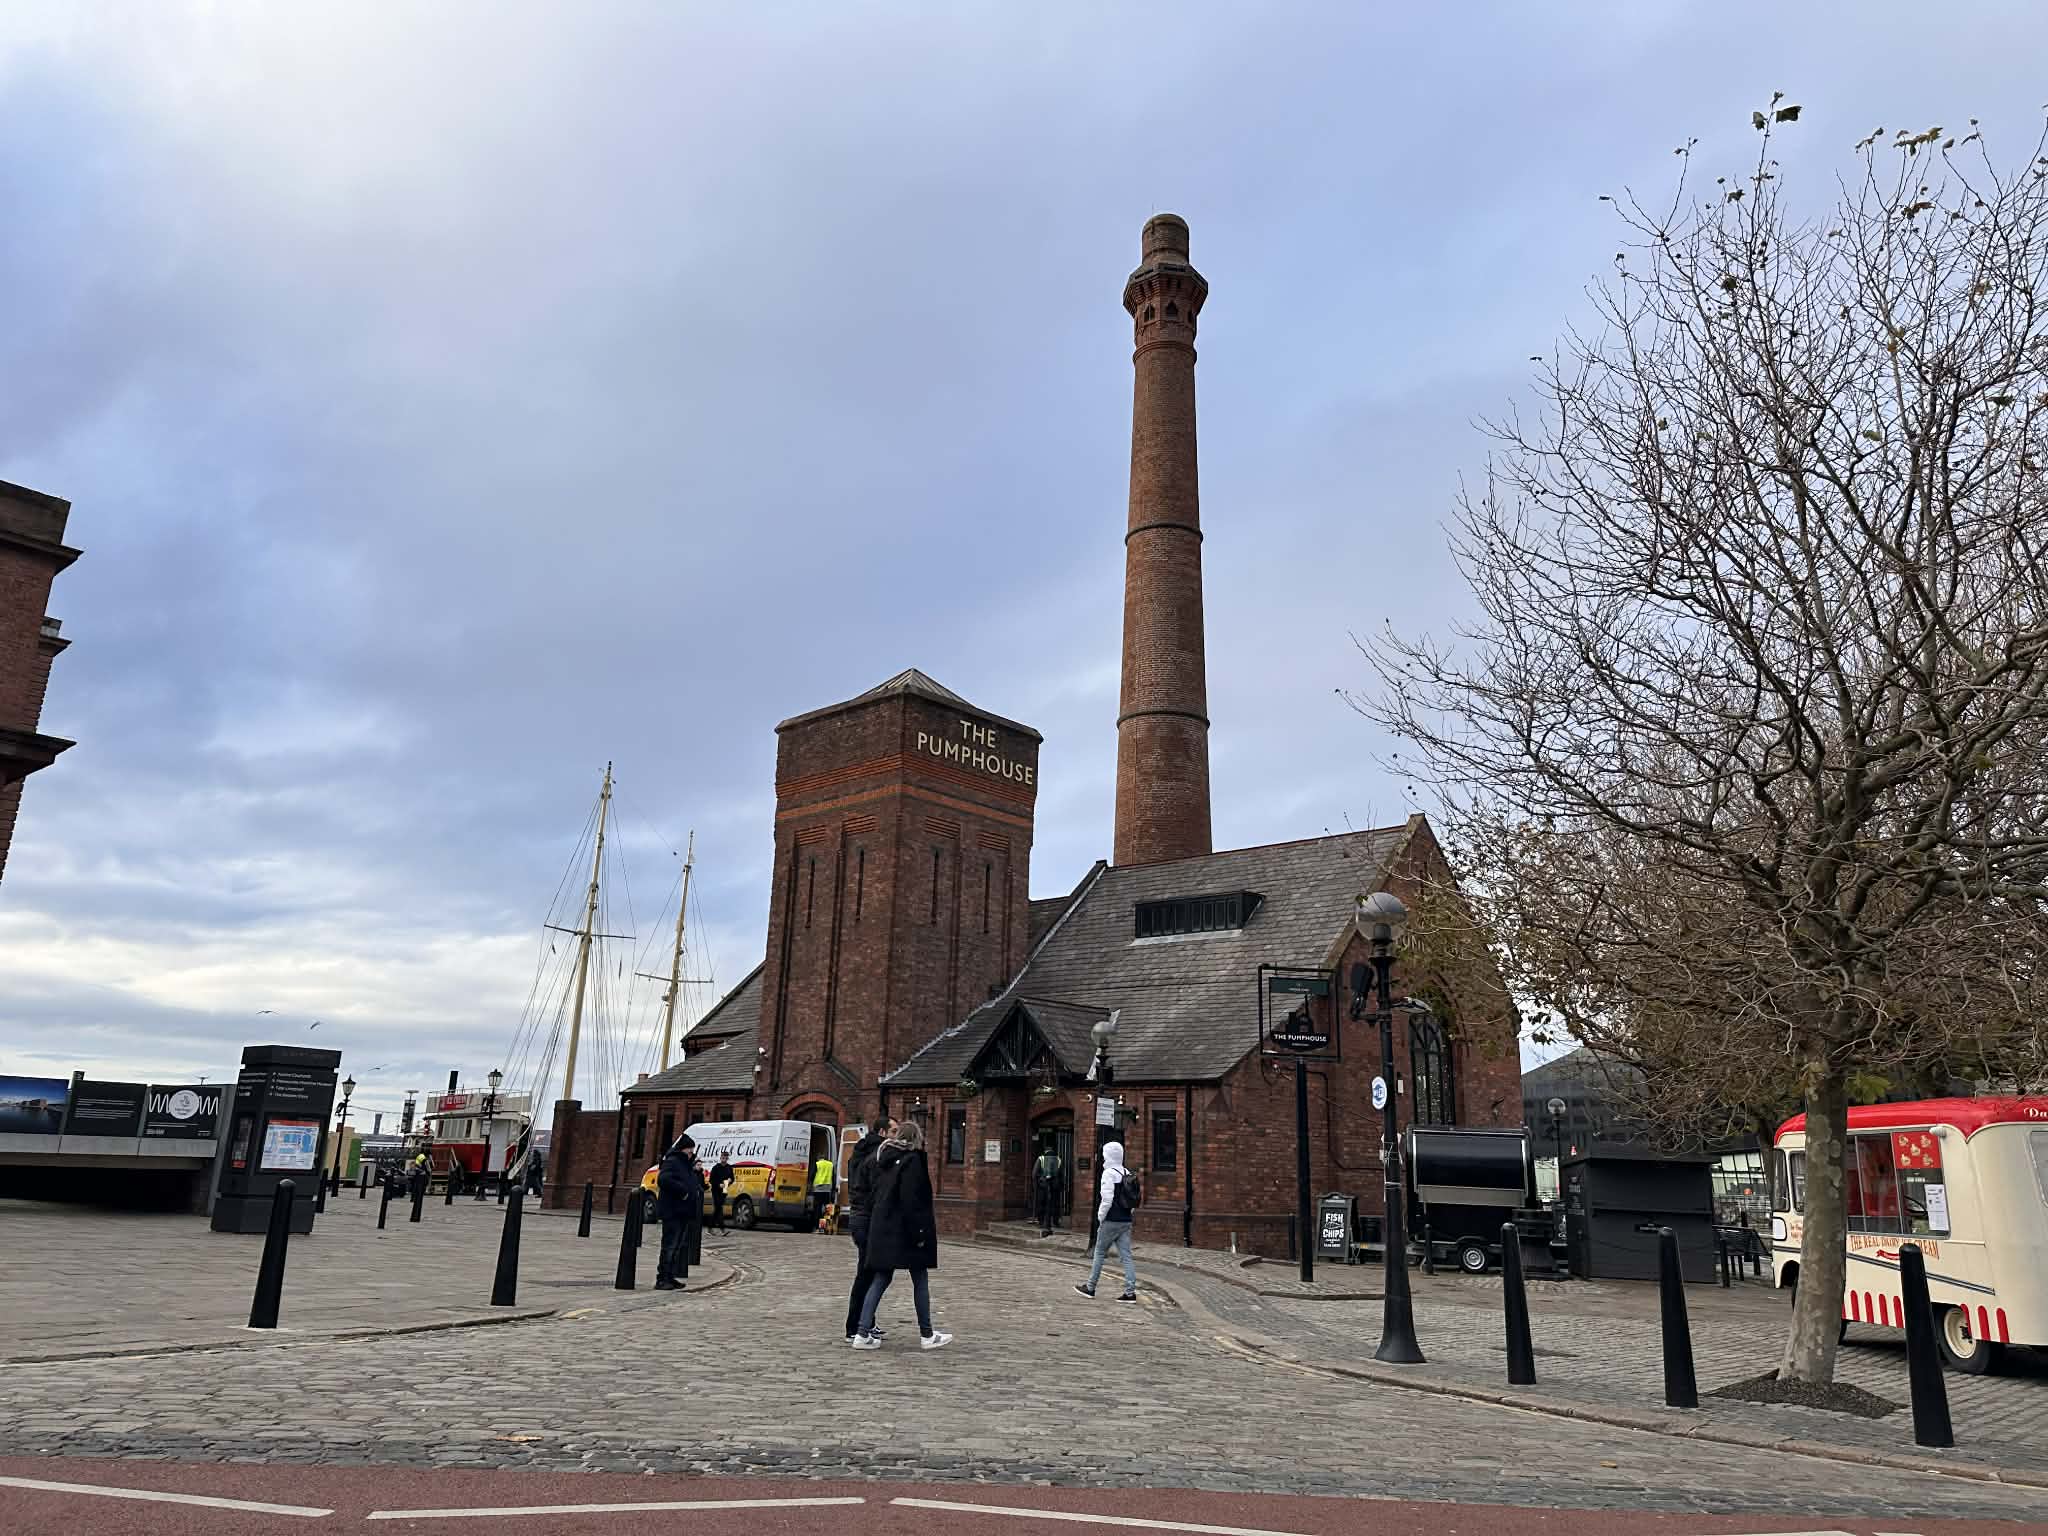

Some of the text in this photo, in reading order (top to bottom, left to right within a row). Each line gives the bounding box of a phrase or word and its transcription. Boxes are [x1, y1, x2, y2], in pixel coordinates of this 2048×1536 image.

[960, 720, 997, 748] THE
[917, 731, 1034, 785] PUMPHOUSE
[1288, 1034, 1328, 1042] PUMPHOUSE
[737, 1140, 769, 1158] Cider
[1325, 1213, 1344, 1223] FISH
[1322, 1229, 1345, 1239] CHIPS
[1851, 1235, 1862, 1251] THE
[1863, 1236, 1880, 1248] REAL
